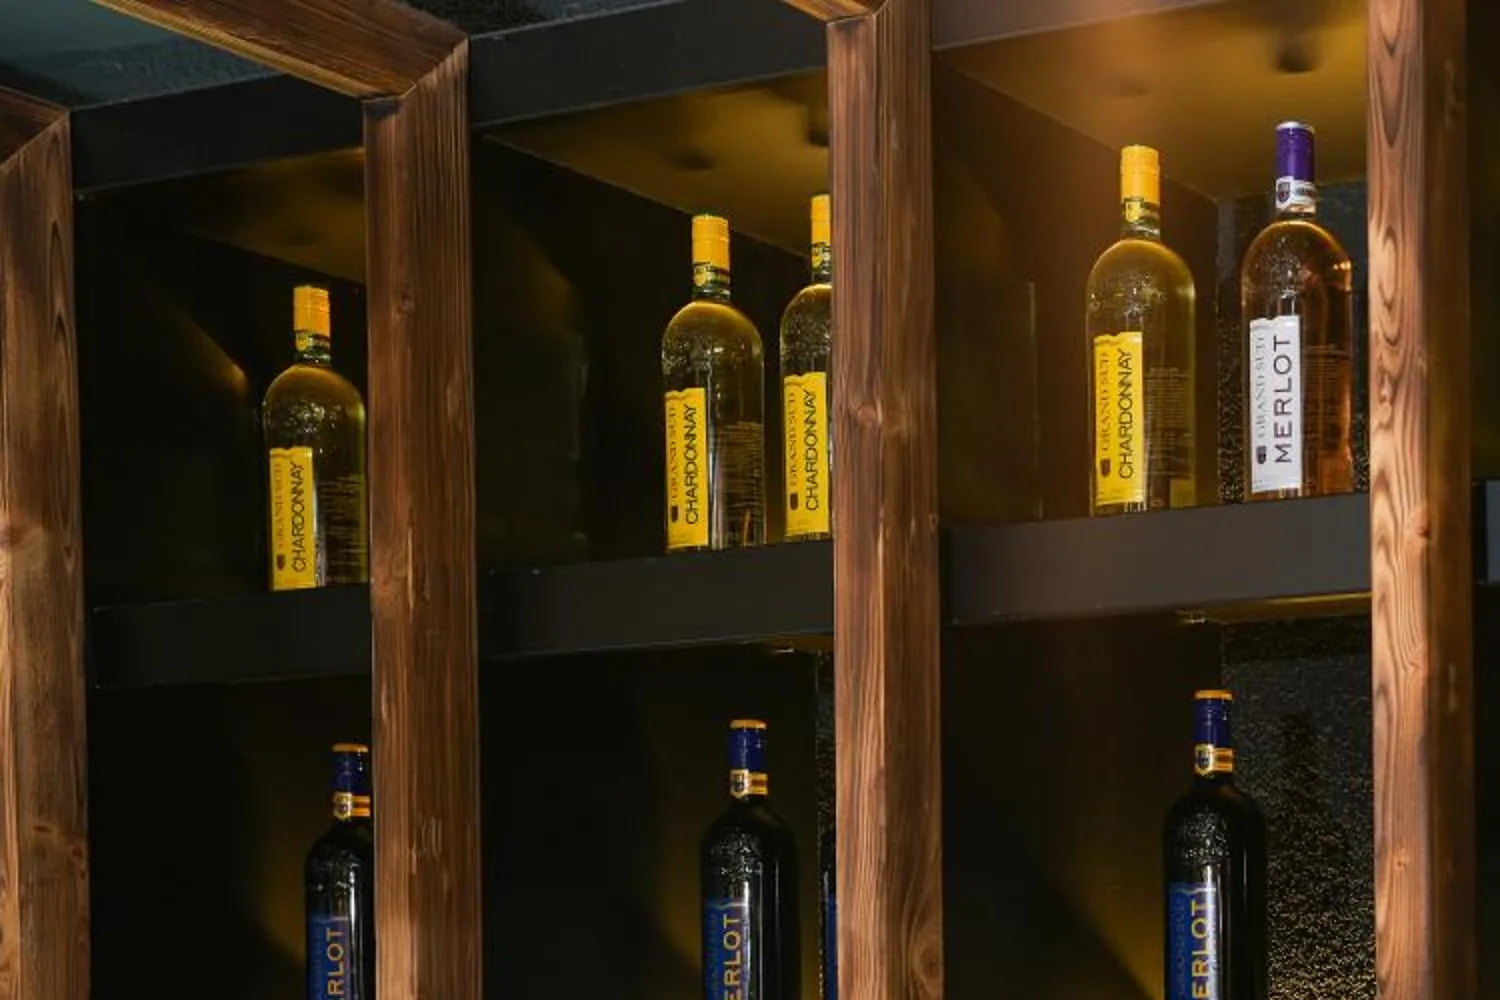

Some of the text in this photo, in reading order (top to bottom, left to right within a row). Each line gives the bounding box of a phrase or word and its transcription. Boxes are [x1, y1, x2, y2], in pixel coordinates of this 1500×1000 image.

[804, 389, 819, 511] CHARDONNAY
[1117, 348, 1133, 479] CHARDONNAY
[1273, 335, 1293, 463] MERLOT
[290, 462, 306, 572] CHARDONNAY
[683, 404, 699, 524] CHARDONNAY
